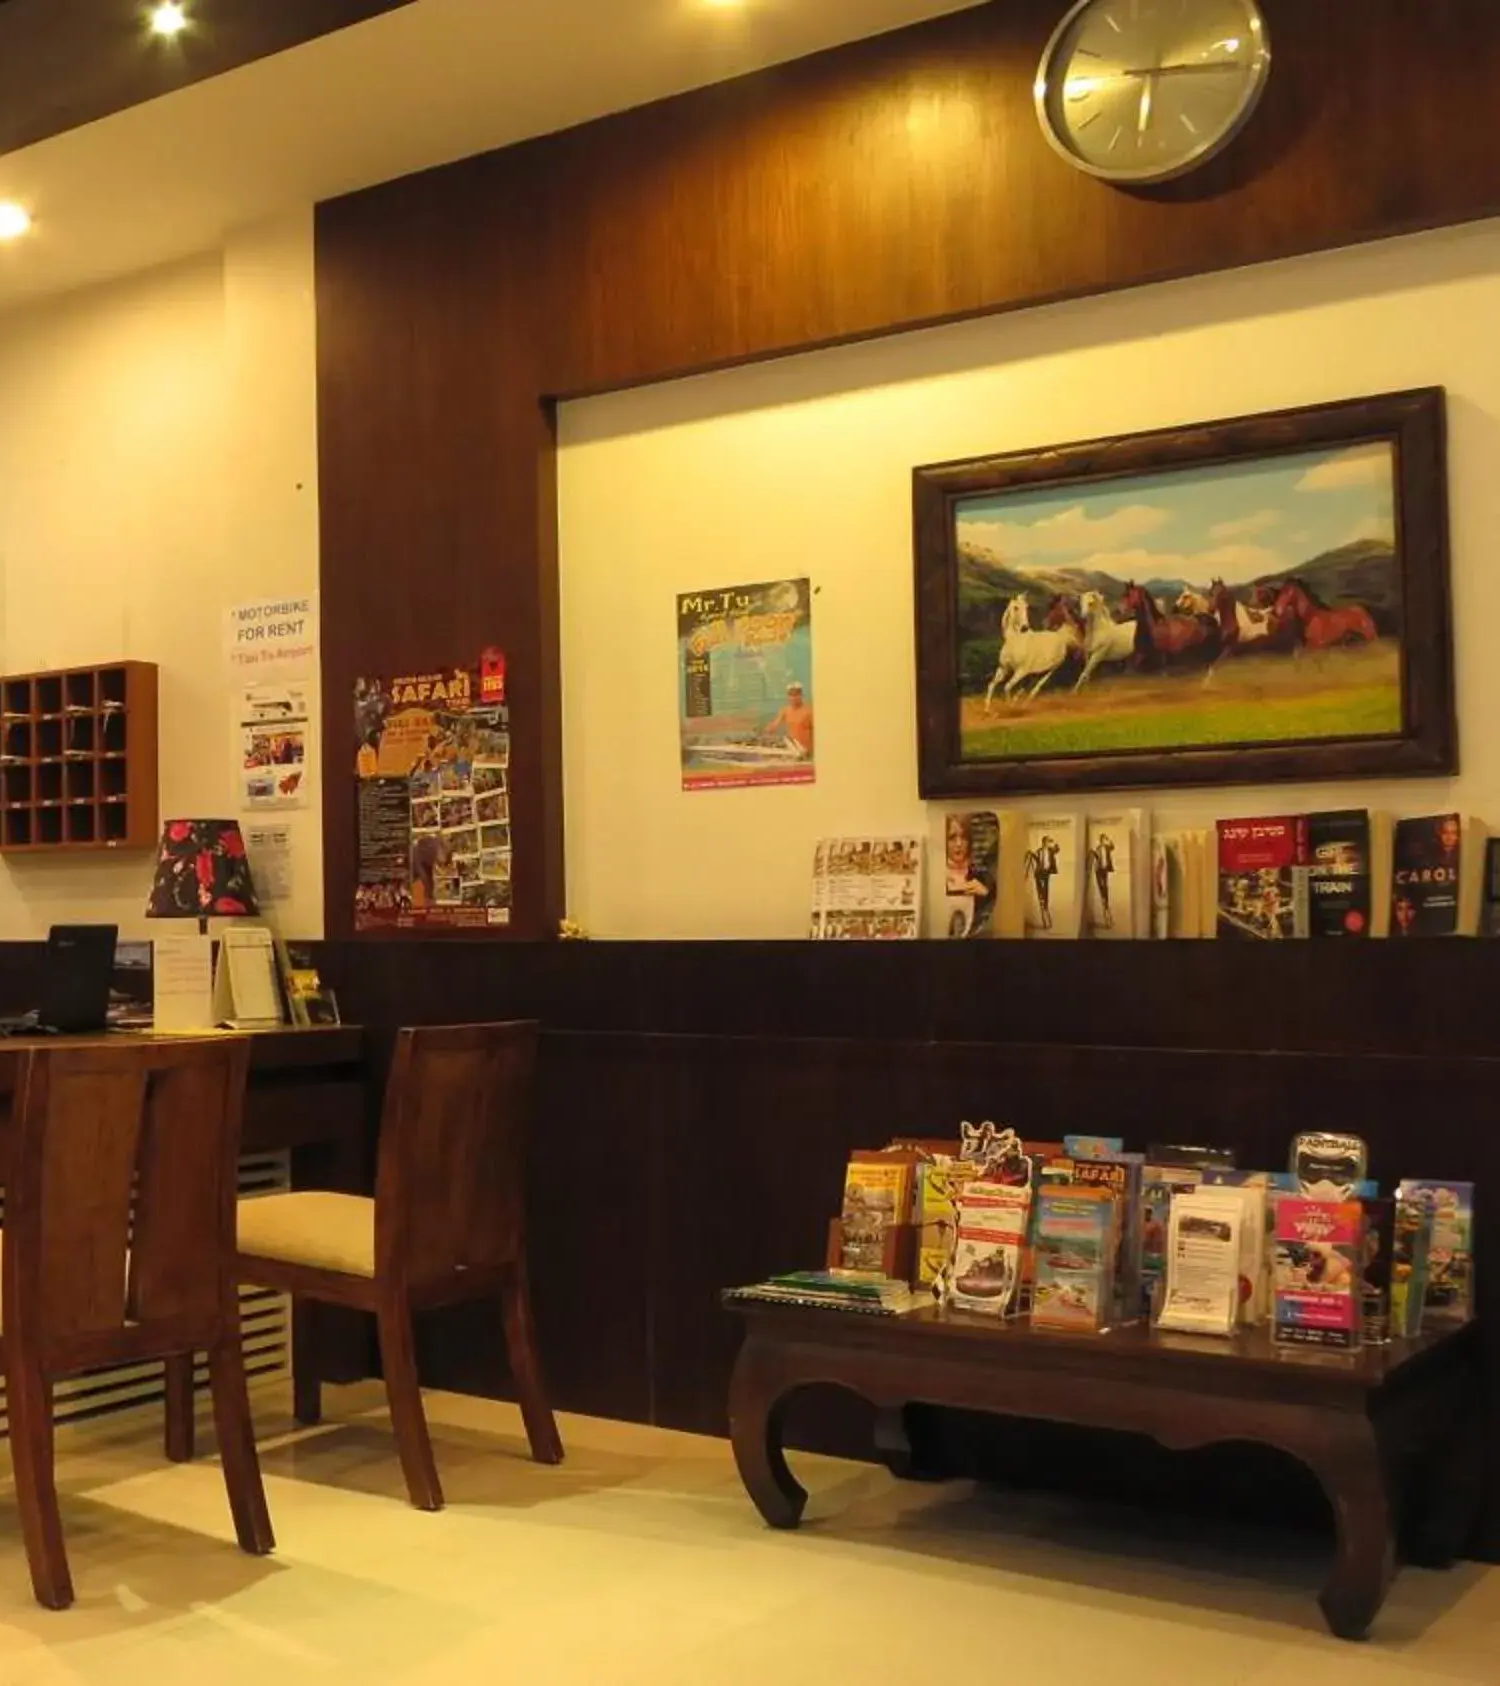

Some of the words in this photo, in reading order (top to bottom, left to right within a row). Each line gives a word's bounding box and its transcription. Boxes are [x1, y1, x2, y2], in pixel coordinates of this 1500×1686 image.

[238, 599, 309, 621] MOTORBIKE
[237, 625, 265, 642] FOR
[267, 619, 304, 638] RENT
[391, 675, 470, 704] SAFARI
[1396, 867, 1457, 885] CAROL
[1312, 881, 1353, 894] TRAIN
